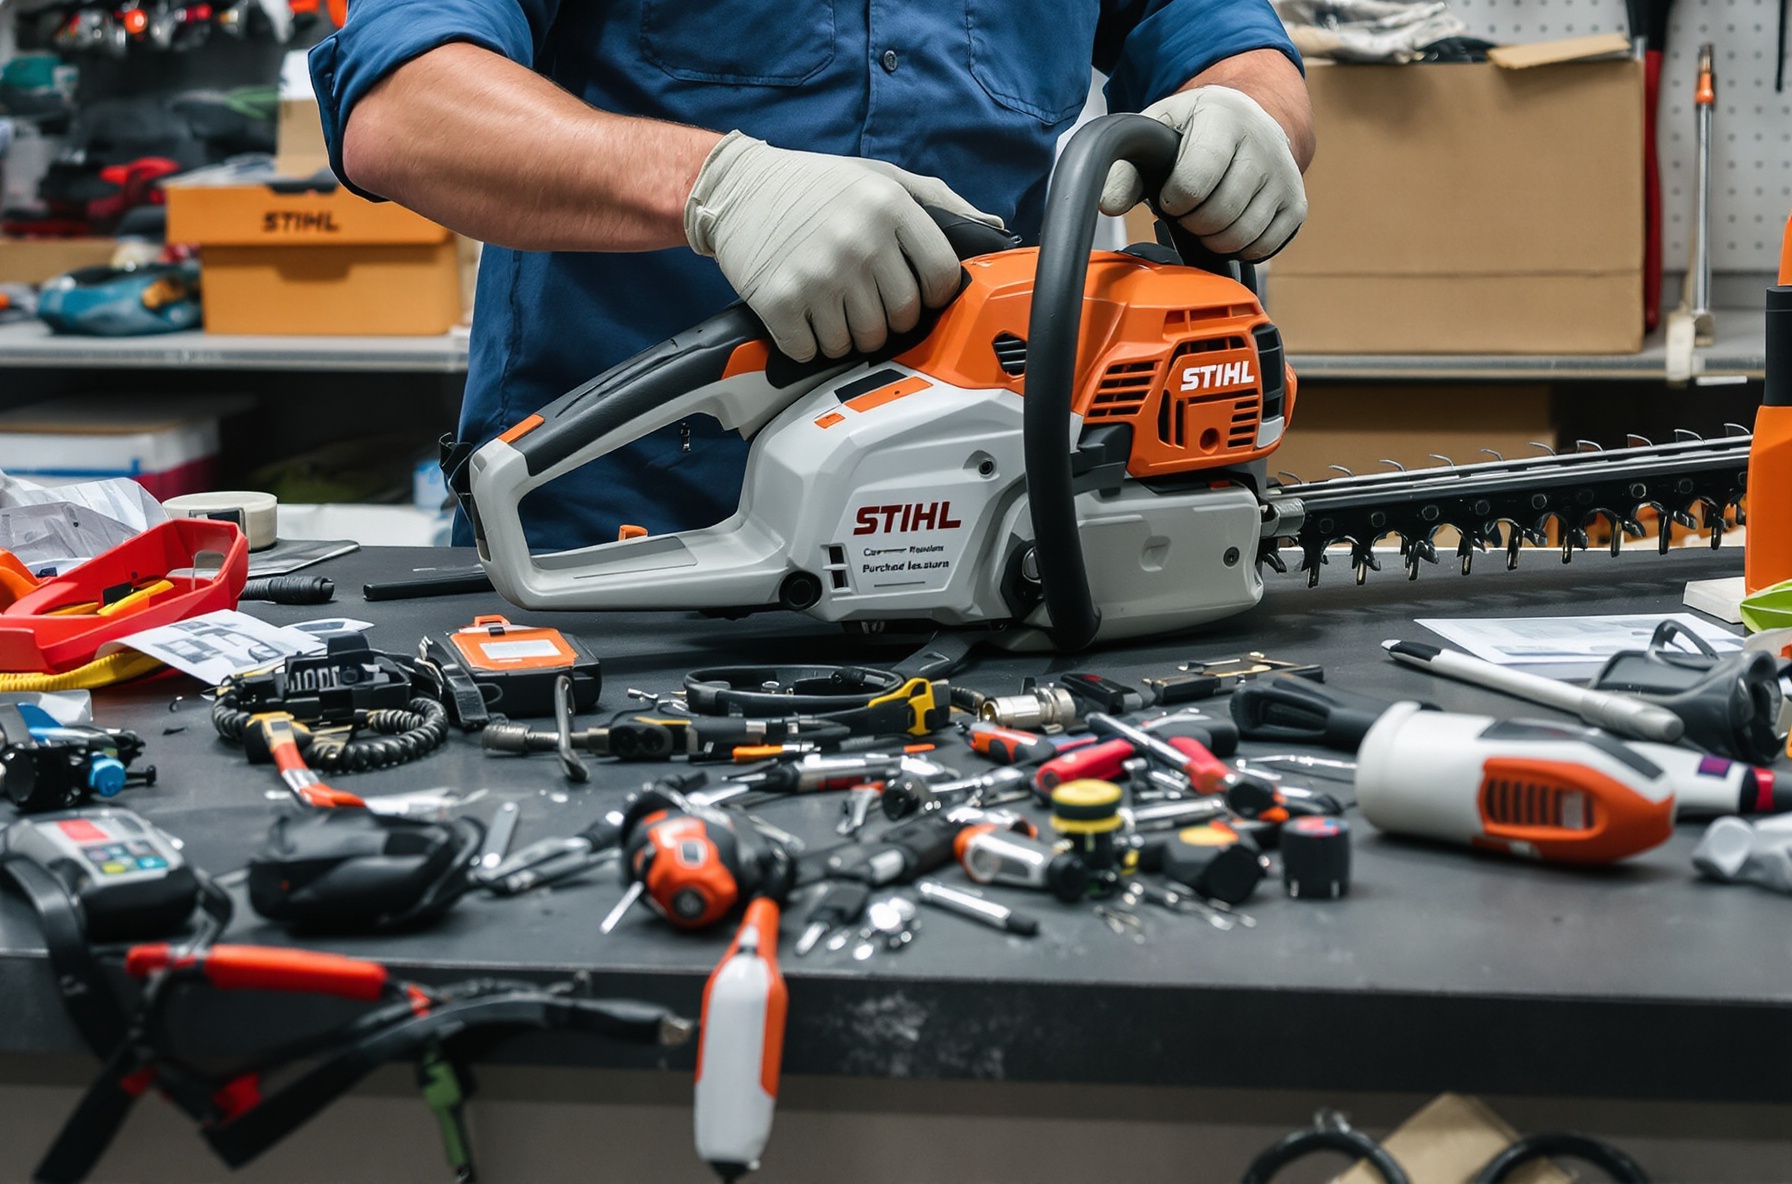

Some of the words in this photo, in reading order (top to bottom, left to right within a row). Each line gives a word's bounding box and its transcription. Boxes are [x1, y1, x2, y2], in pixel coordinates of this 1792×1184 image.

[263, 211, 340, 233] STIHL
[1180, 360, 1255, 392] STIHL
[853, 501, 961, 536] STIHL
